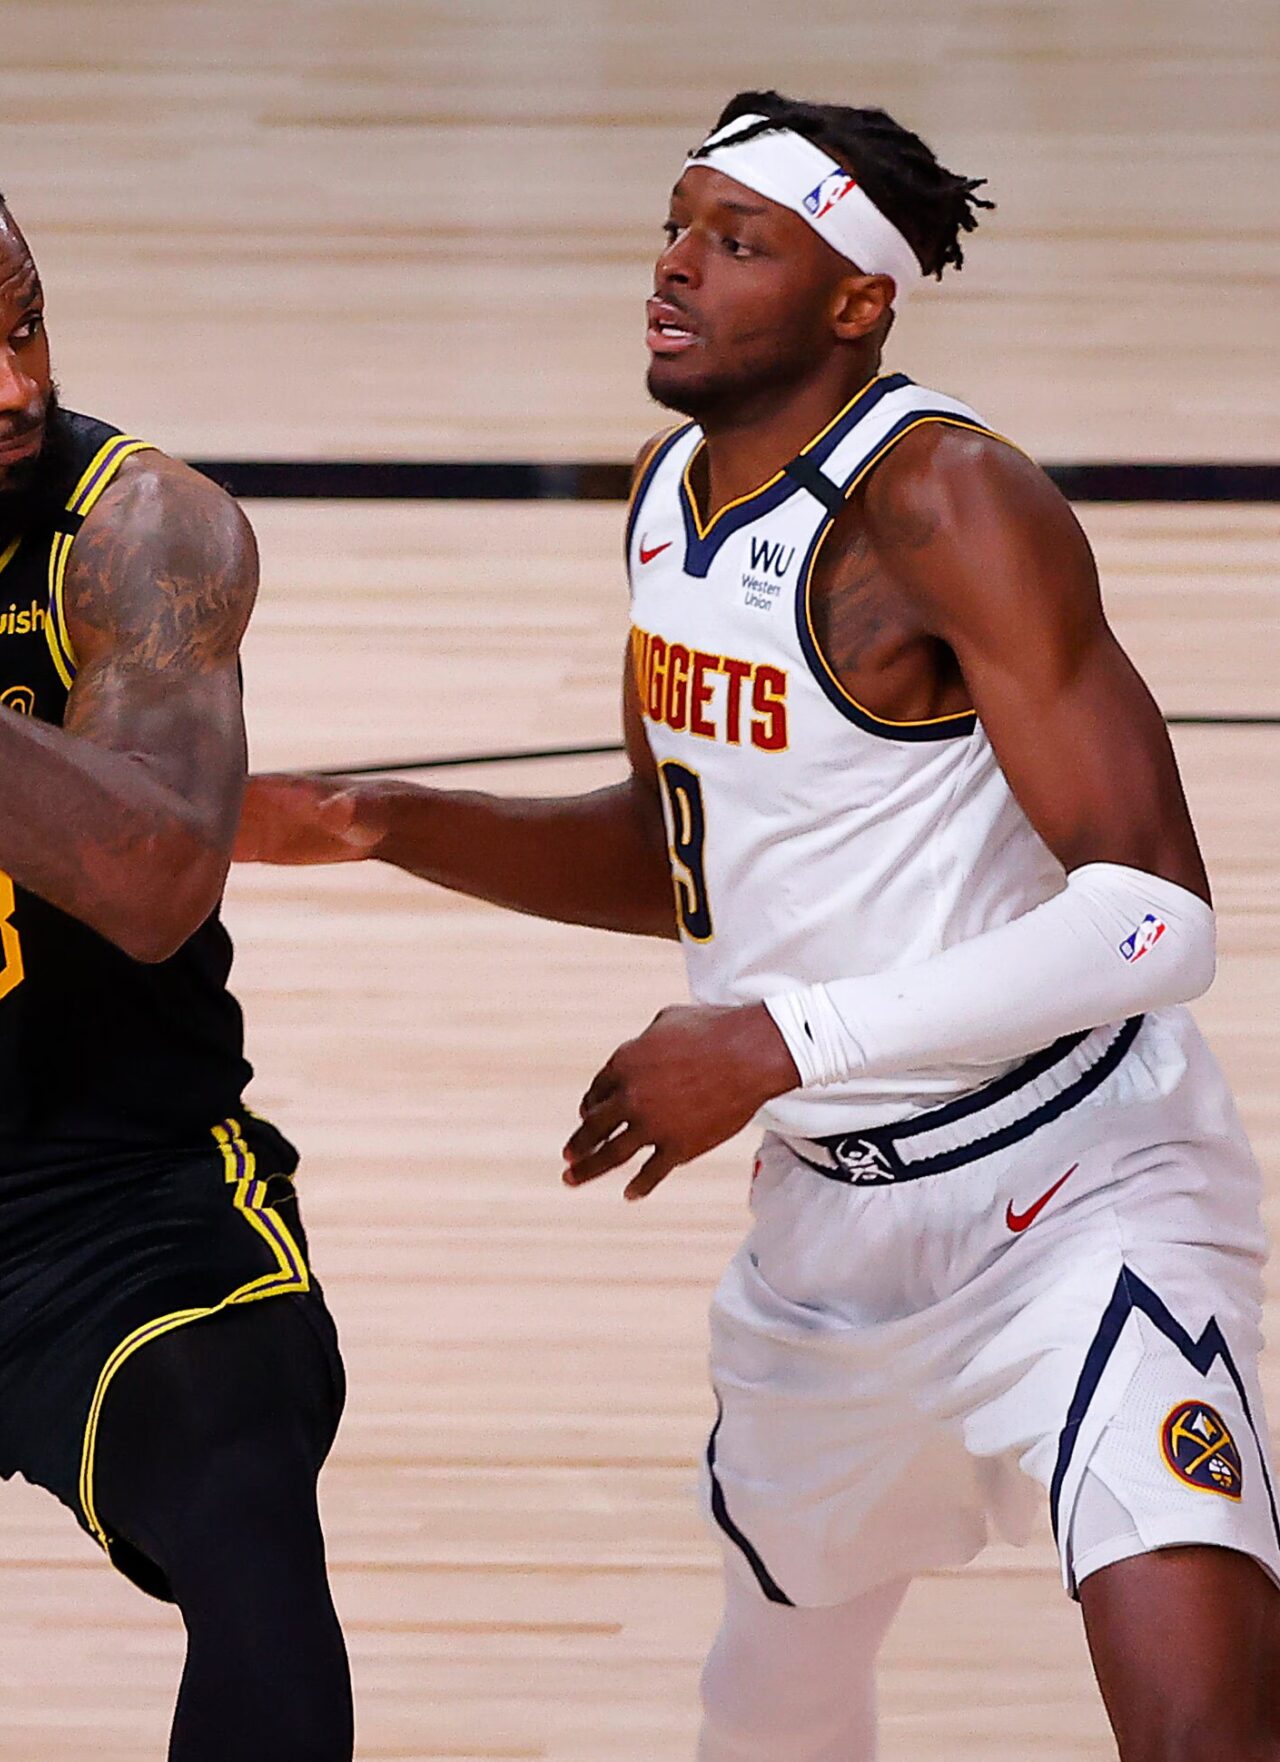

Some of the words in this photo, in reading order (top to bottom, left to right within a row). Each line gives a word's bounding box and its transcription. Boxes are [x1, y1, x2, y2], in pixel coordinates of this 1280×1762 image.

[751, 536, 795, 577] WU
[742, 573, 780, 596] Western
[745, 591, 771, 610] Union
[631, 625, 789, 753] GGETS
[658, 758, 714, 944] 9
